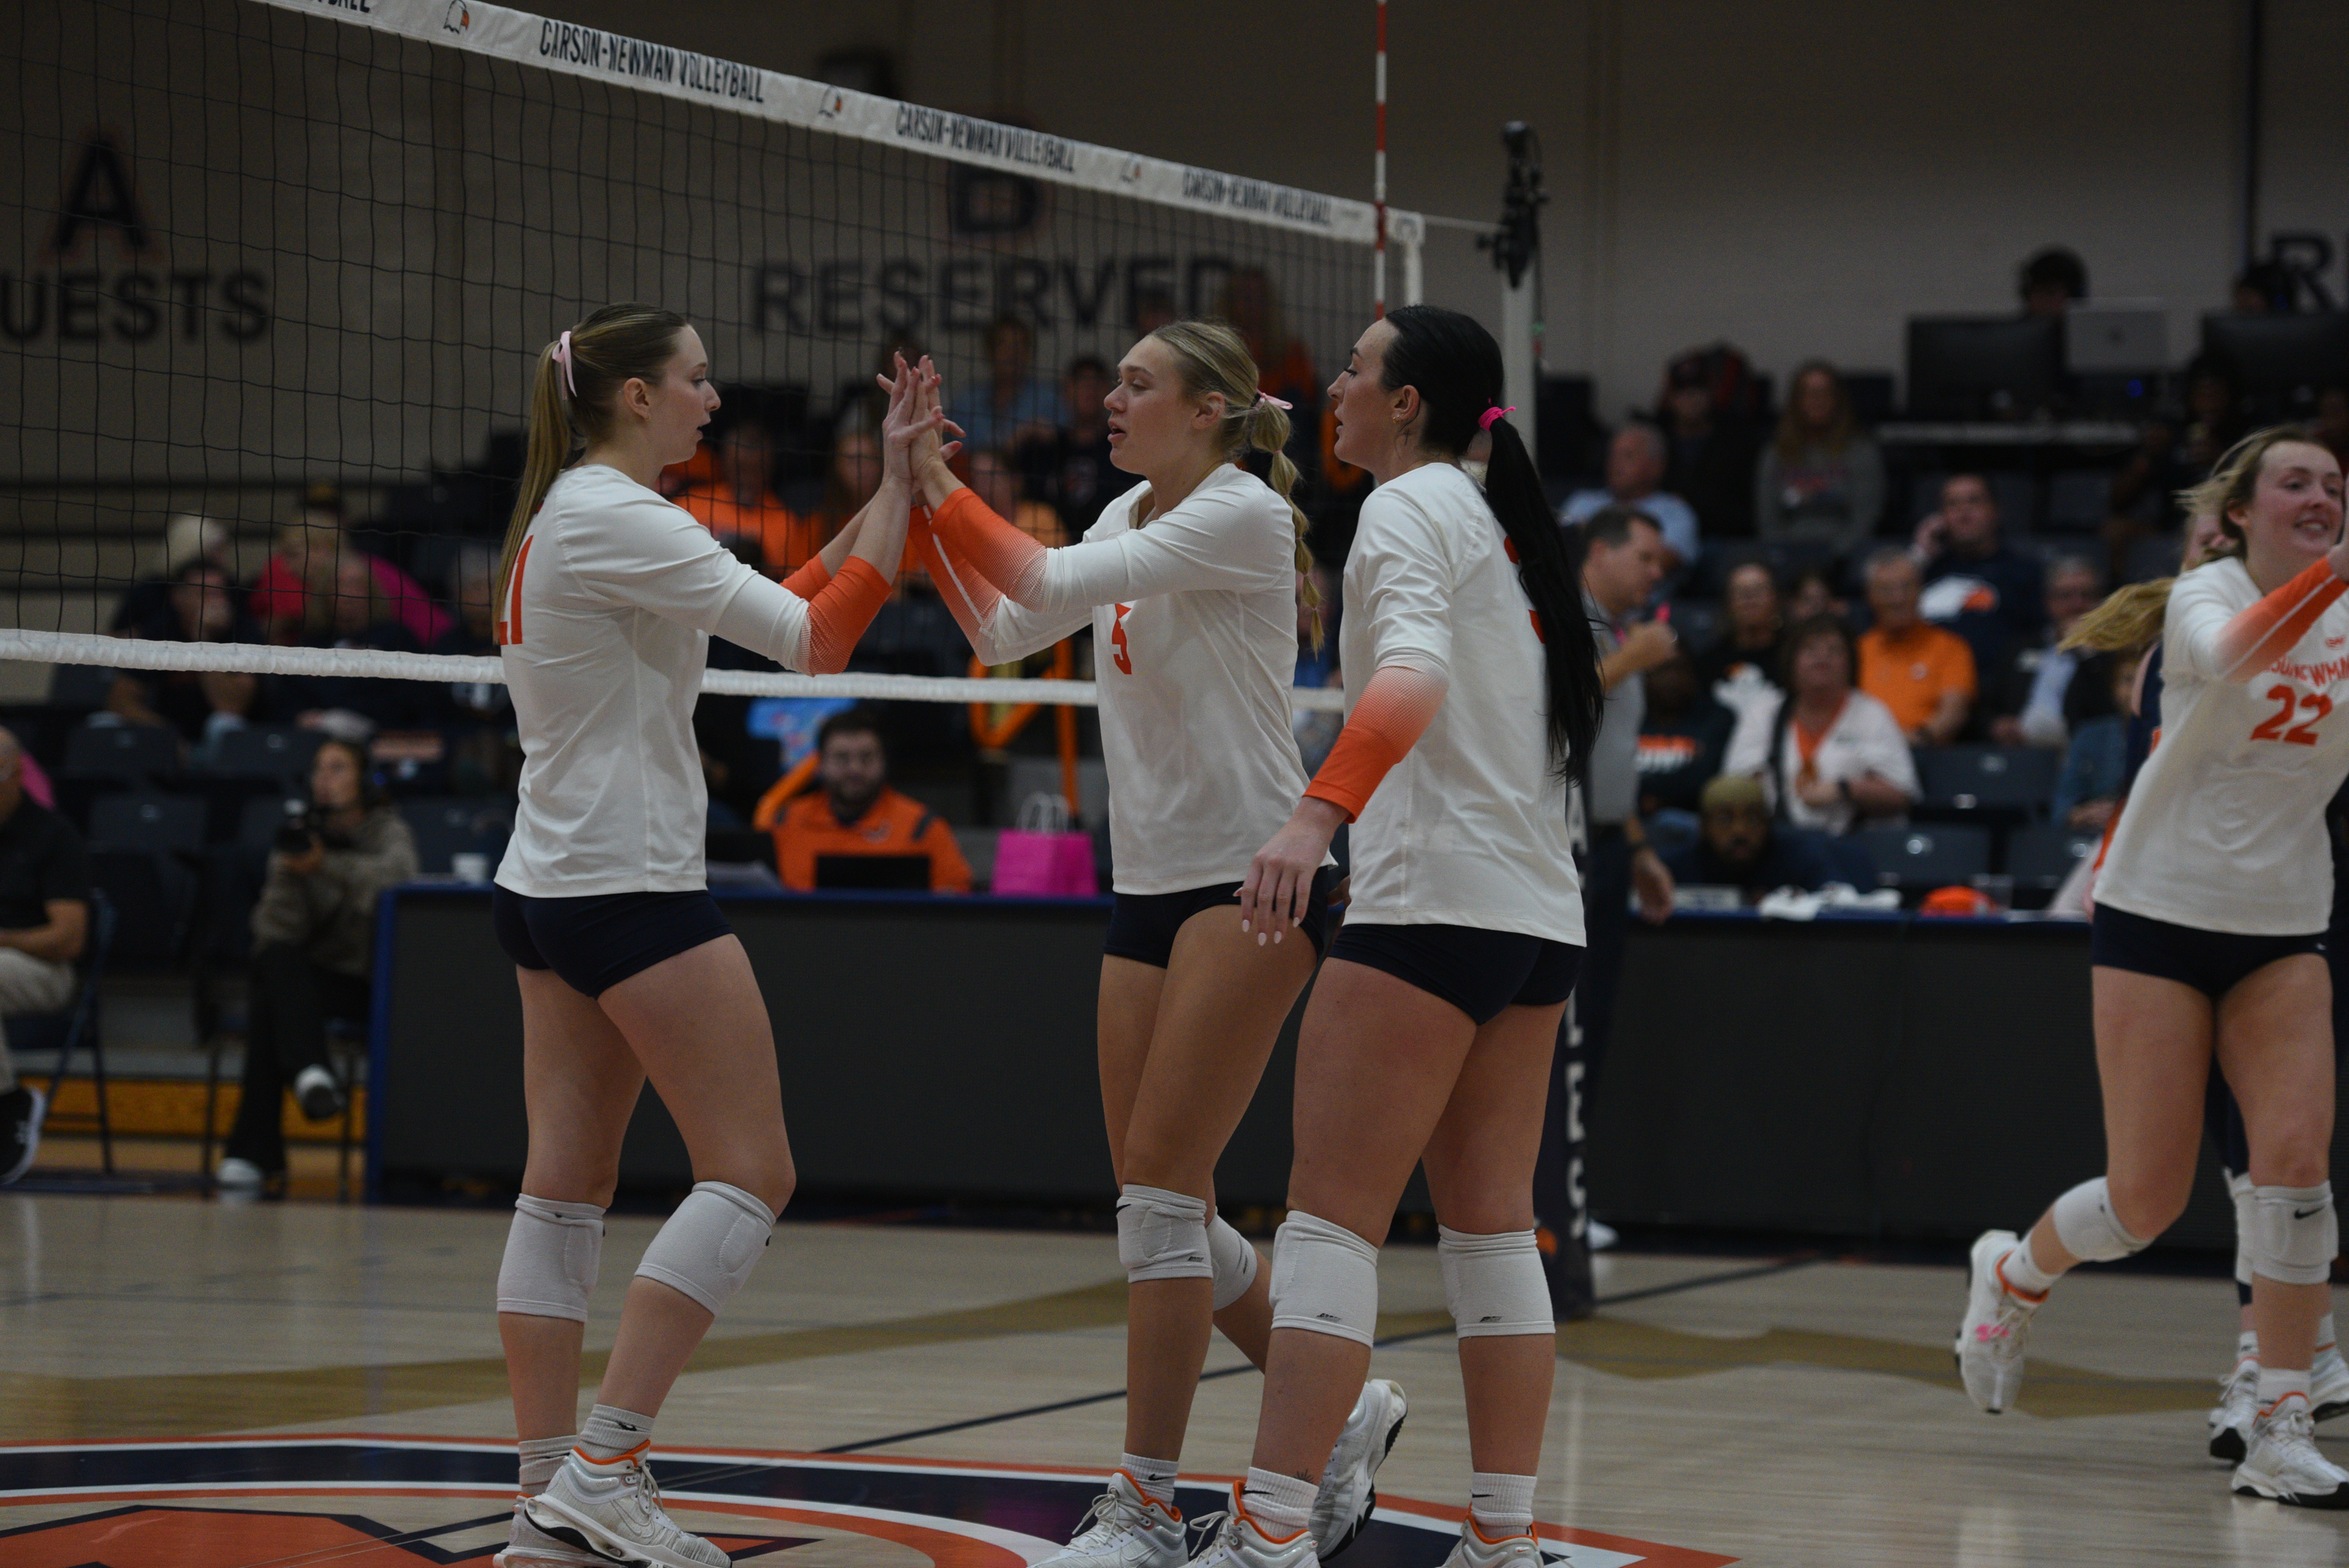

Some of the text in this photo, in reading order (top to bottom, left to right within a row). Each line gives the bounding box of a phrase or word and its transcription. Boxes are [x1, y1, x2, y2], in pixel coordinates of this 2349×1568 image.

[540, 20, 764, 103] CARSON-NEWMAN VOLLEYBALL
[48, 133, 154, 257] A
[2250, 685, 2334, 747] 22
